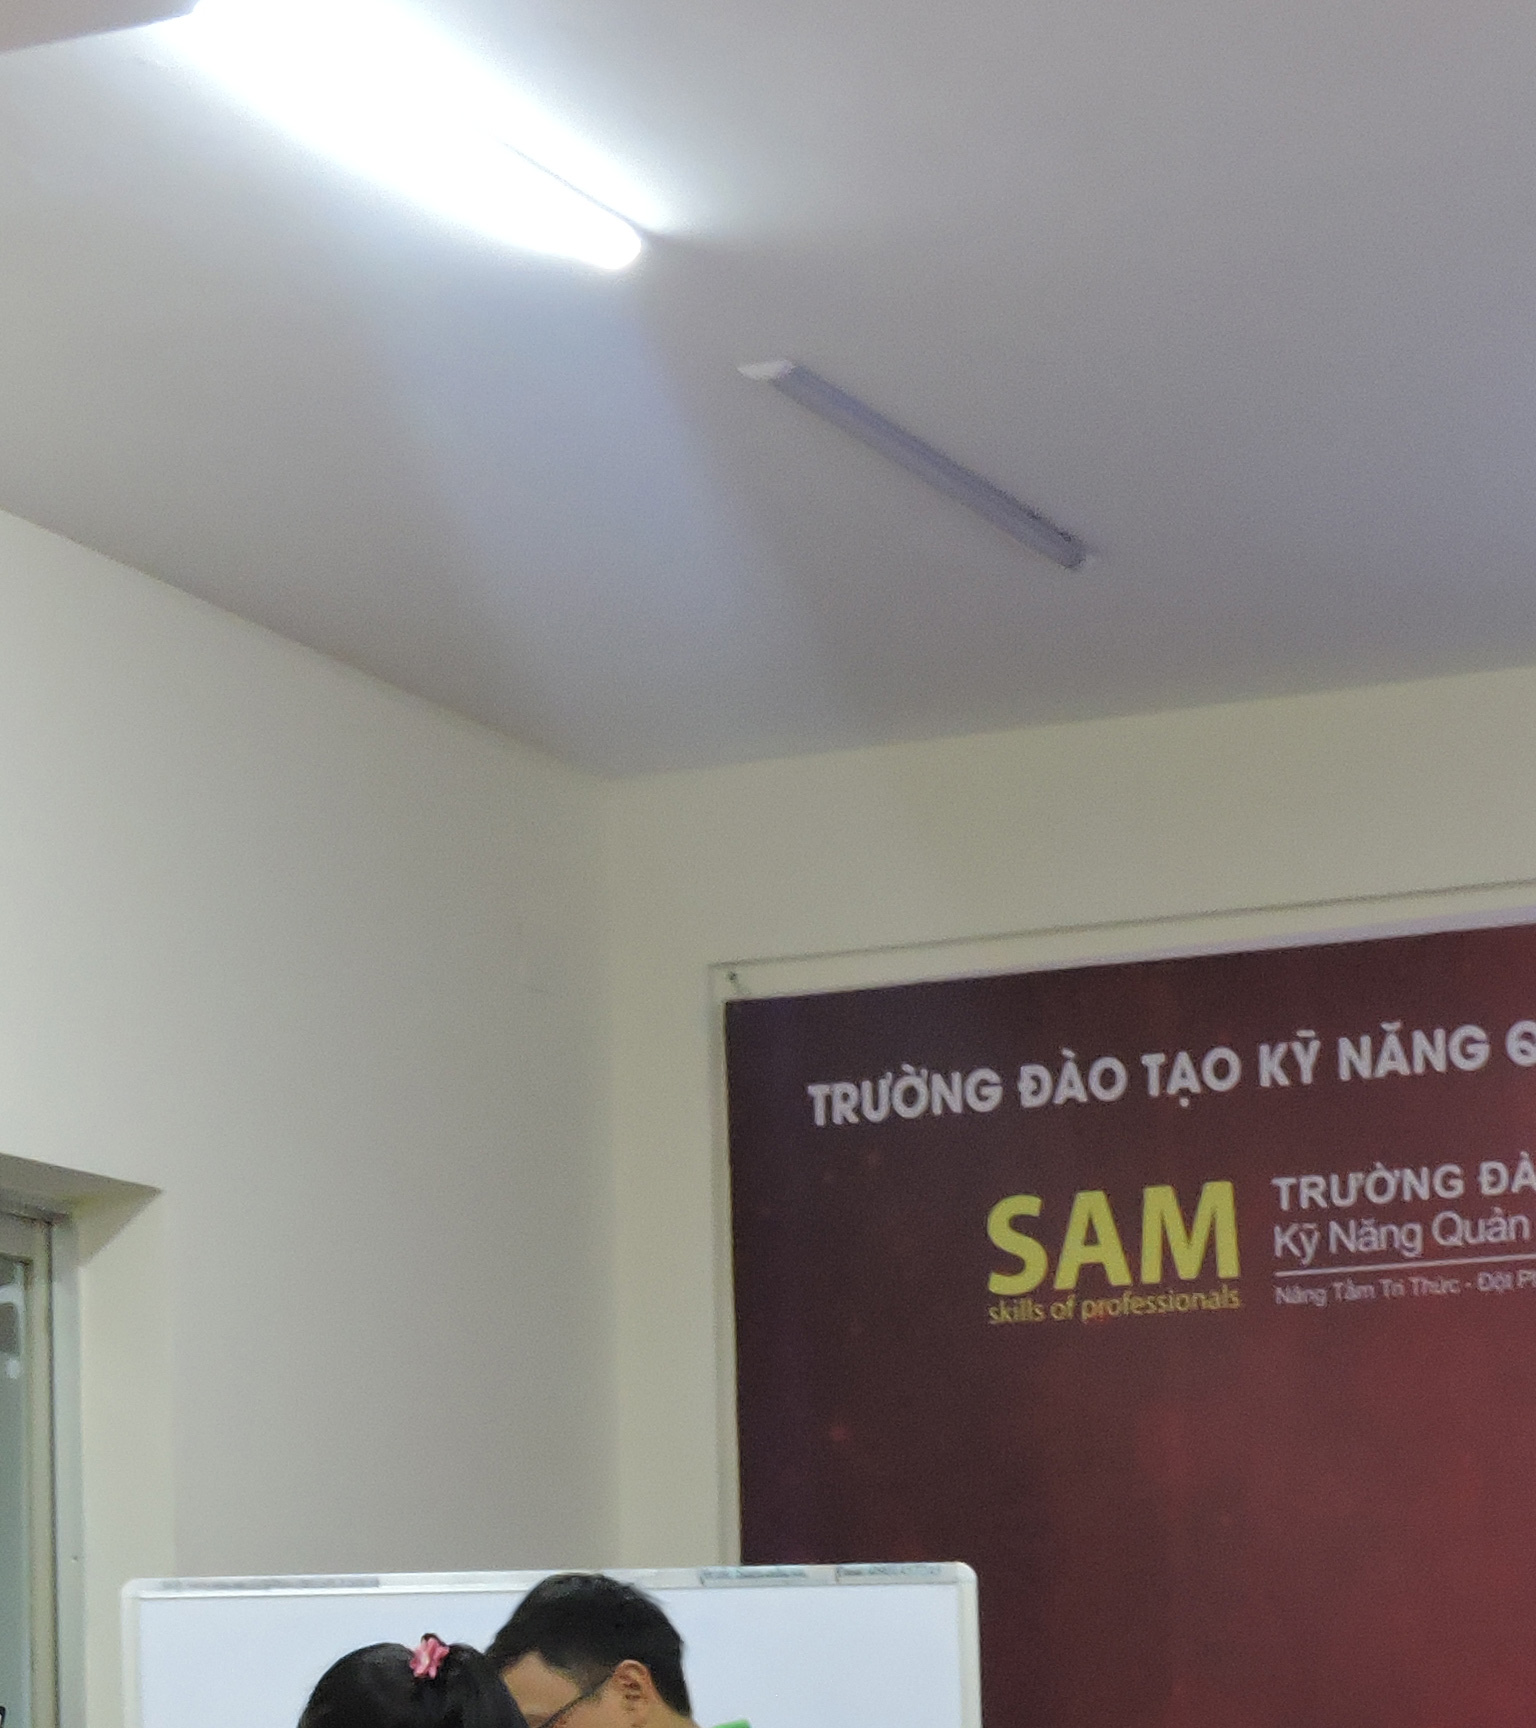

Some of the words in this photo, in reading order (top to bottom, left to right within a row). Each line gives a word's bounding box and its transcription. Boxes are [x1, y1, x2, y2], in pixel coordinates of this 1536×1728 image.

[807, 1063, 1003, 1126] TRƯỜNG
[1018, 1049, 1127, 1108] ĐÀO
[1141, 1047, 1241, 1107] TẠO
[1259, 1030, 1321, 1087] KỸ
[1337, 1021, 1490, 1081] NĂNG
[1271, 1162, 1464, 1211] TRƯỜNG
[987, 1180, 1240, 1296] SAM
[1274, 1222, 1320, 1265] Kỹ
[1329, 1218, 1423, 1257] Năng
[1431, 1207, 1530, 1247] Quản
[989, 1298, 1045, 1324] skills
[1050, 1294, 1075, 1320] of
[1081, 1284, 1241, 1323] professionals
